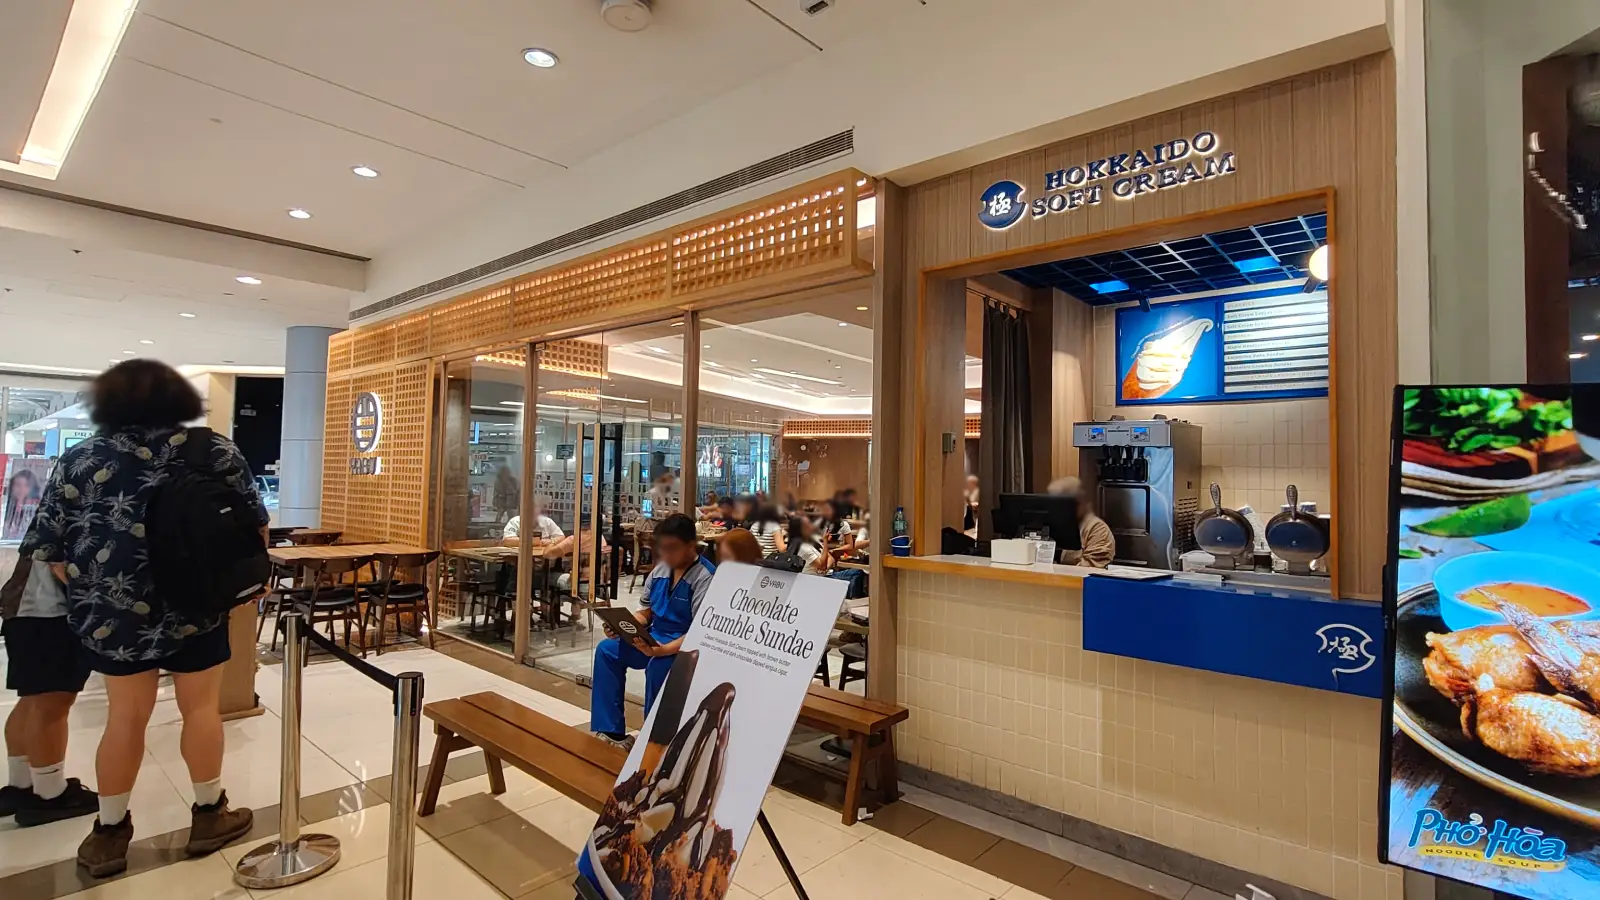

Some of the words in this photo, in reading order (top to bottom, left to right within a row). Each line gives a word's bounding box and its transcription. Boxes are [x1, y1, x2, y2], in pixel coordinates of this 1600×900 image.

[1044, 131, 1217, 191] HOKKAIDO
[1031, 184, 1103, 218] SOFT
[1112, 151, 1237, 198] CREAM
[989, 192, 1011, 217] 極
[768, 578, 786, 590] YABU
[729, 587, 799, 625] Chocolate
[700, 605, 755, 641] Crumble
[753, 620, 814, 660] Sundae
[1425, 848, 1479, 858] NOODLE
[1497, 857, 1542, 868] SOUP
